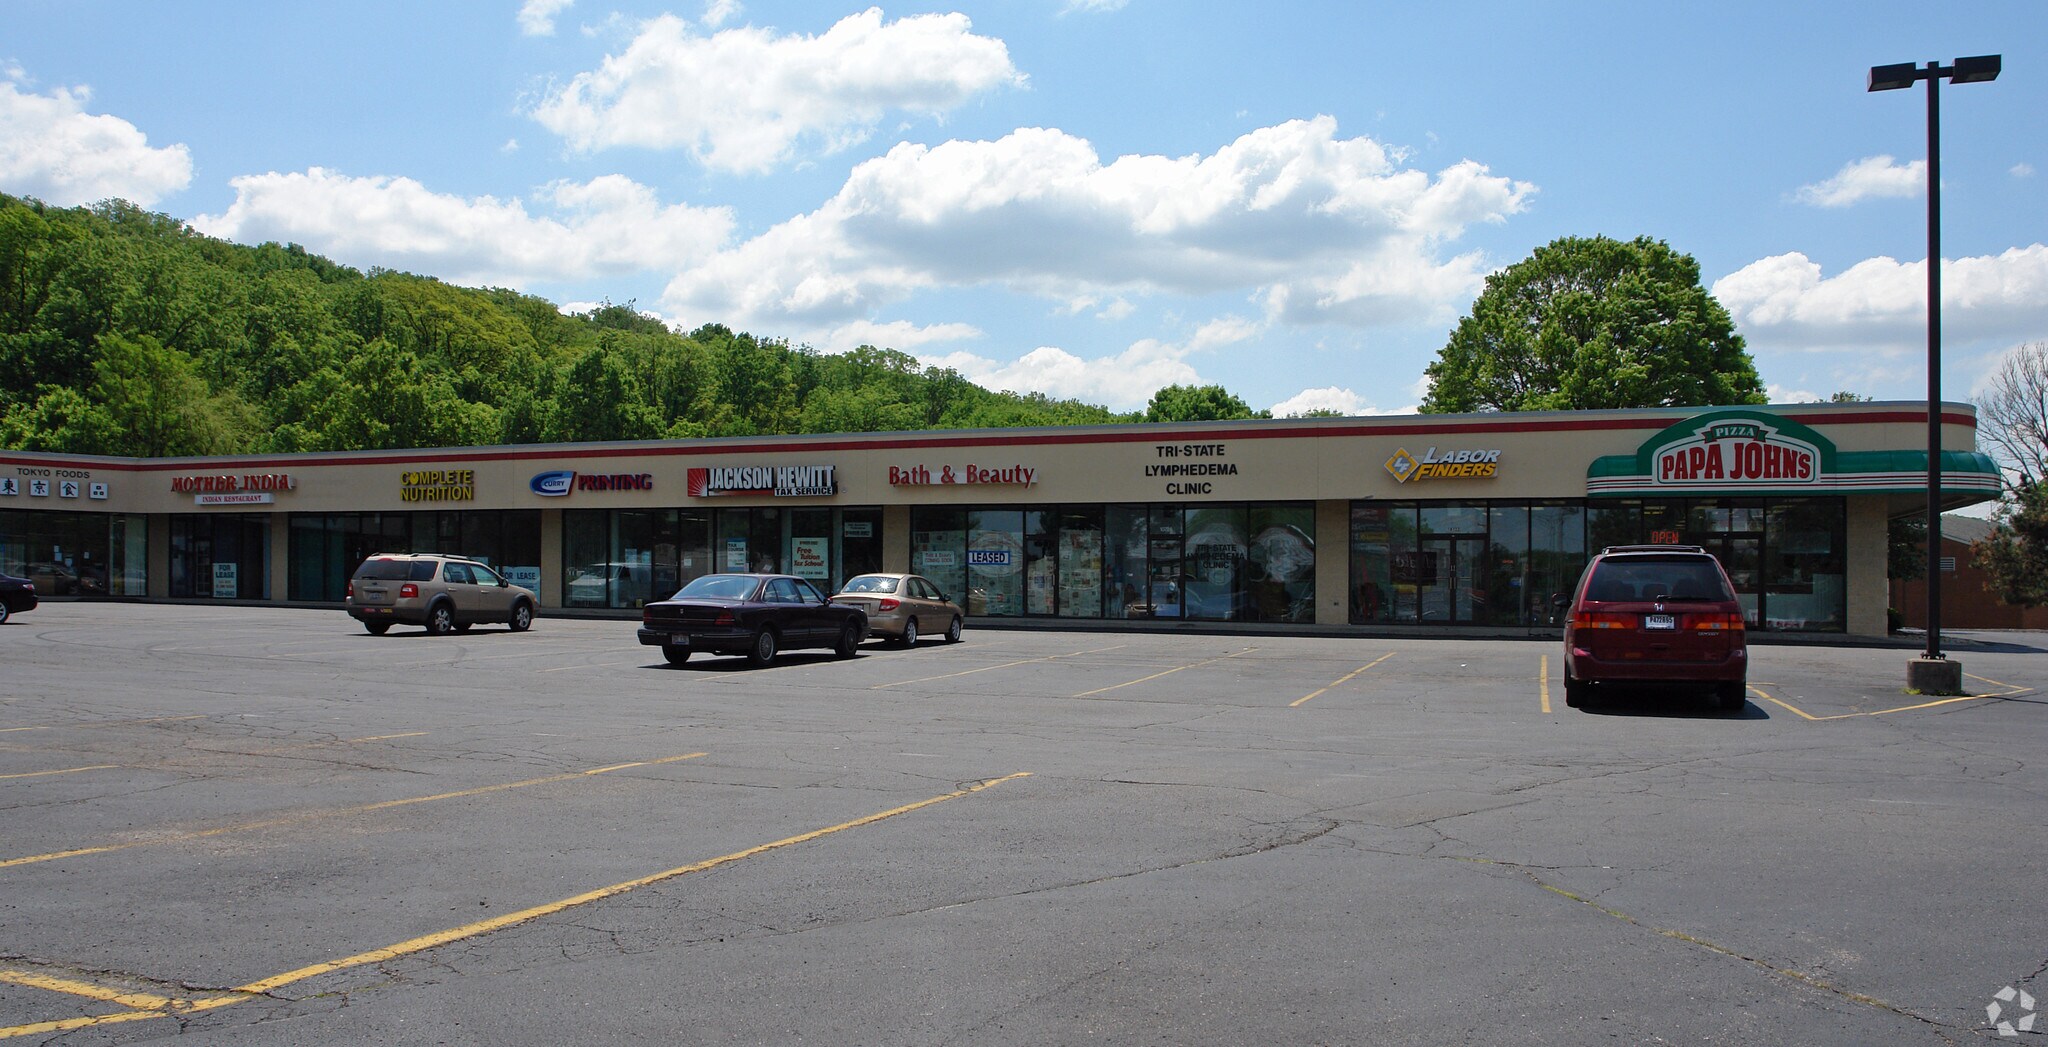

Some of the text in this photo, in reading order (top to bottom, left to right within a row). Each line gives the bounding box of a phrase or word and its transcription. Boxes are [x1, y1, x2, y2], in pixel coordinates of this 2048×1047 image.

[1716, 426, 1754, 437] PIZZA
[1156, 444, 1225, 458] TRI-STATE
[1423, 447, 1501, 463] LABOR
[1662, 442, 1811, 480] PAPA JOHN'S
[16, 468, 90, 479] TOKYO FOODS
[889, 463, 1035, 489] Bath & Beauty
[1145, 463, 1238, 477] LYMPHEDEMA
[1414, 463, 1496, 481] FINDERS
[171, 474, 290, 492] MOTHER INDIA
[401, 470, 473, 485] COMPLETE
[578, 474, 652, 491] PRINTING
[708, 466, 834, 489] JACKSON HEWITT
[401, 486, 473, 501] NUTRITION
[775, 487, 832, 496] TAX SERVICE
[1166, 482, 1212, 495] CLINIC
[1652, 531, 1679, 544] OPEN
[972, 553, 1006, 563] LEASED
[516, 572, 536, 580] LEASE
